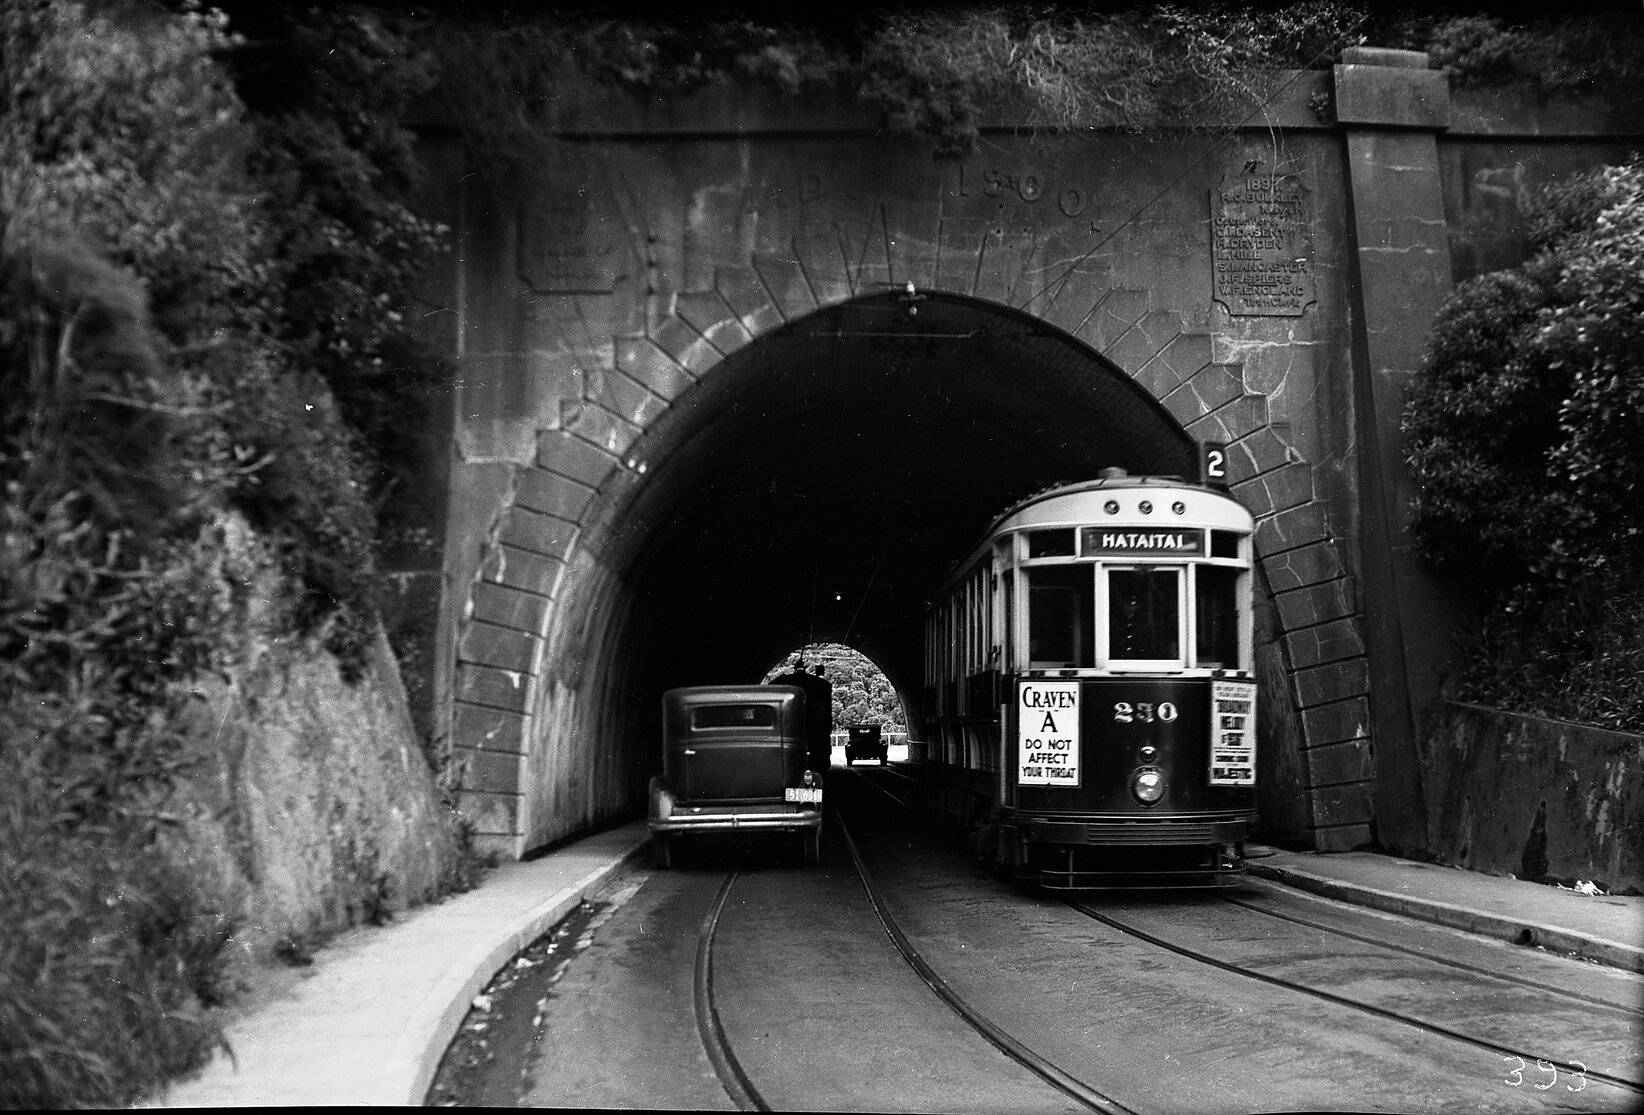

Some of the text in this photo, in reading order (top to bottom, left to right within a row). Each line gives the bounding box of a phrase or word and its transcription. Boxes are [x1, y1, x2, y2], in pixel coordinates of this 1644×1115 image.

[1208, 451, 1224, 477] 2
[1102, 533, 1183, 549] HATAITAI
[1022, 686, 1076, 708] CRAVEN
[1025, 738, 1072, 751] DO NOT
[1028, 752, 1069, 764] AFFECT
[1022, 766, 1076, 778] YOUR THROAT
